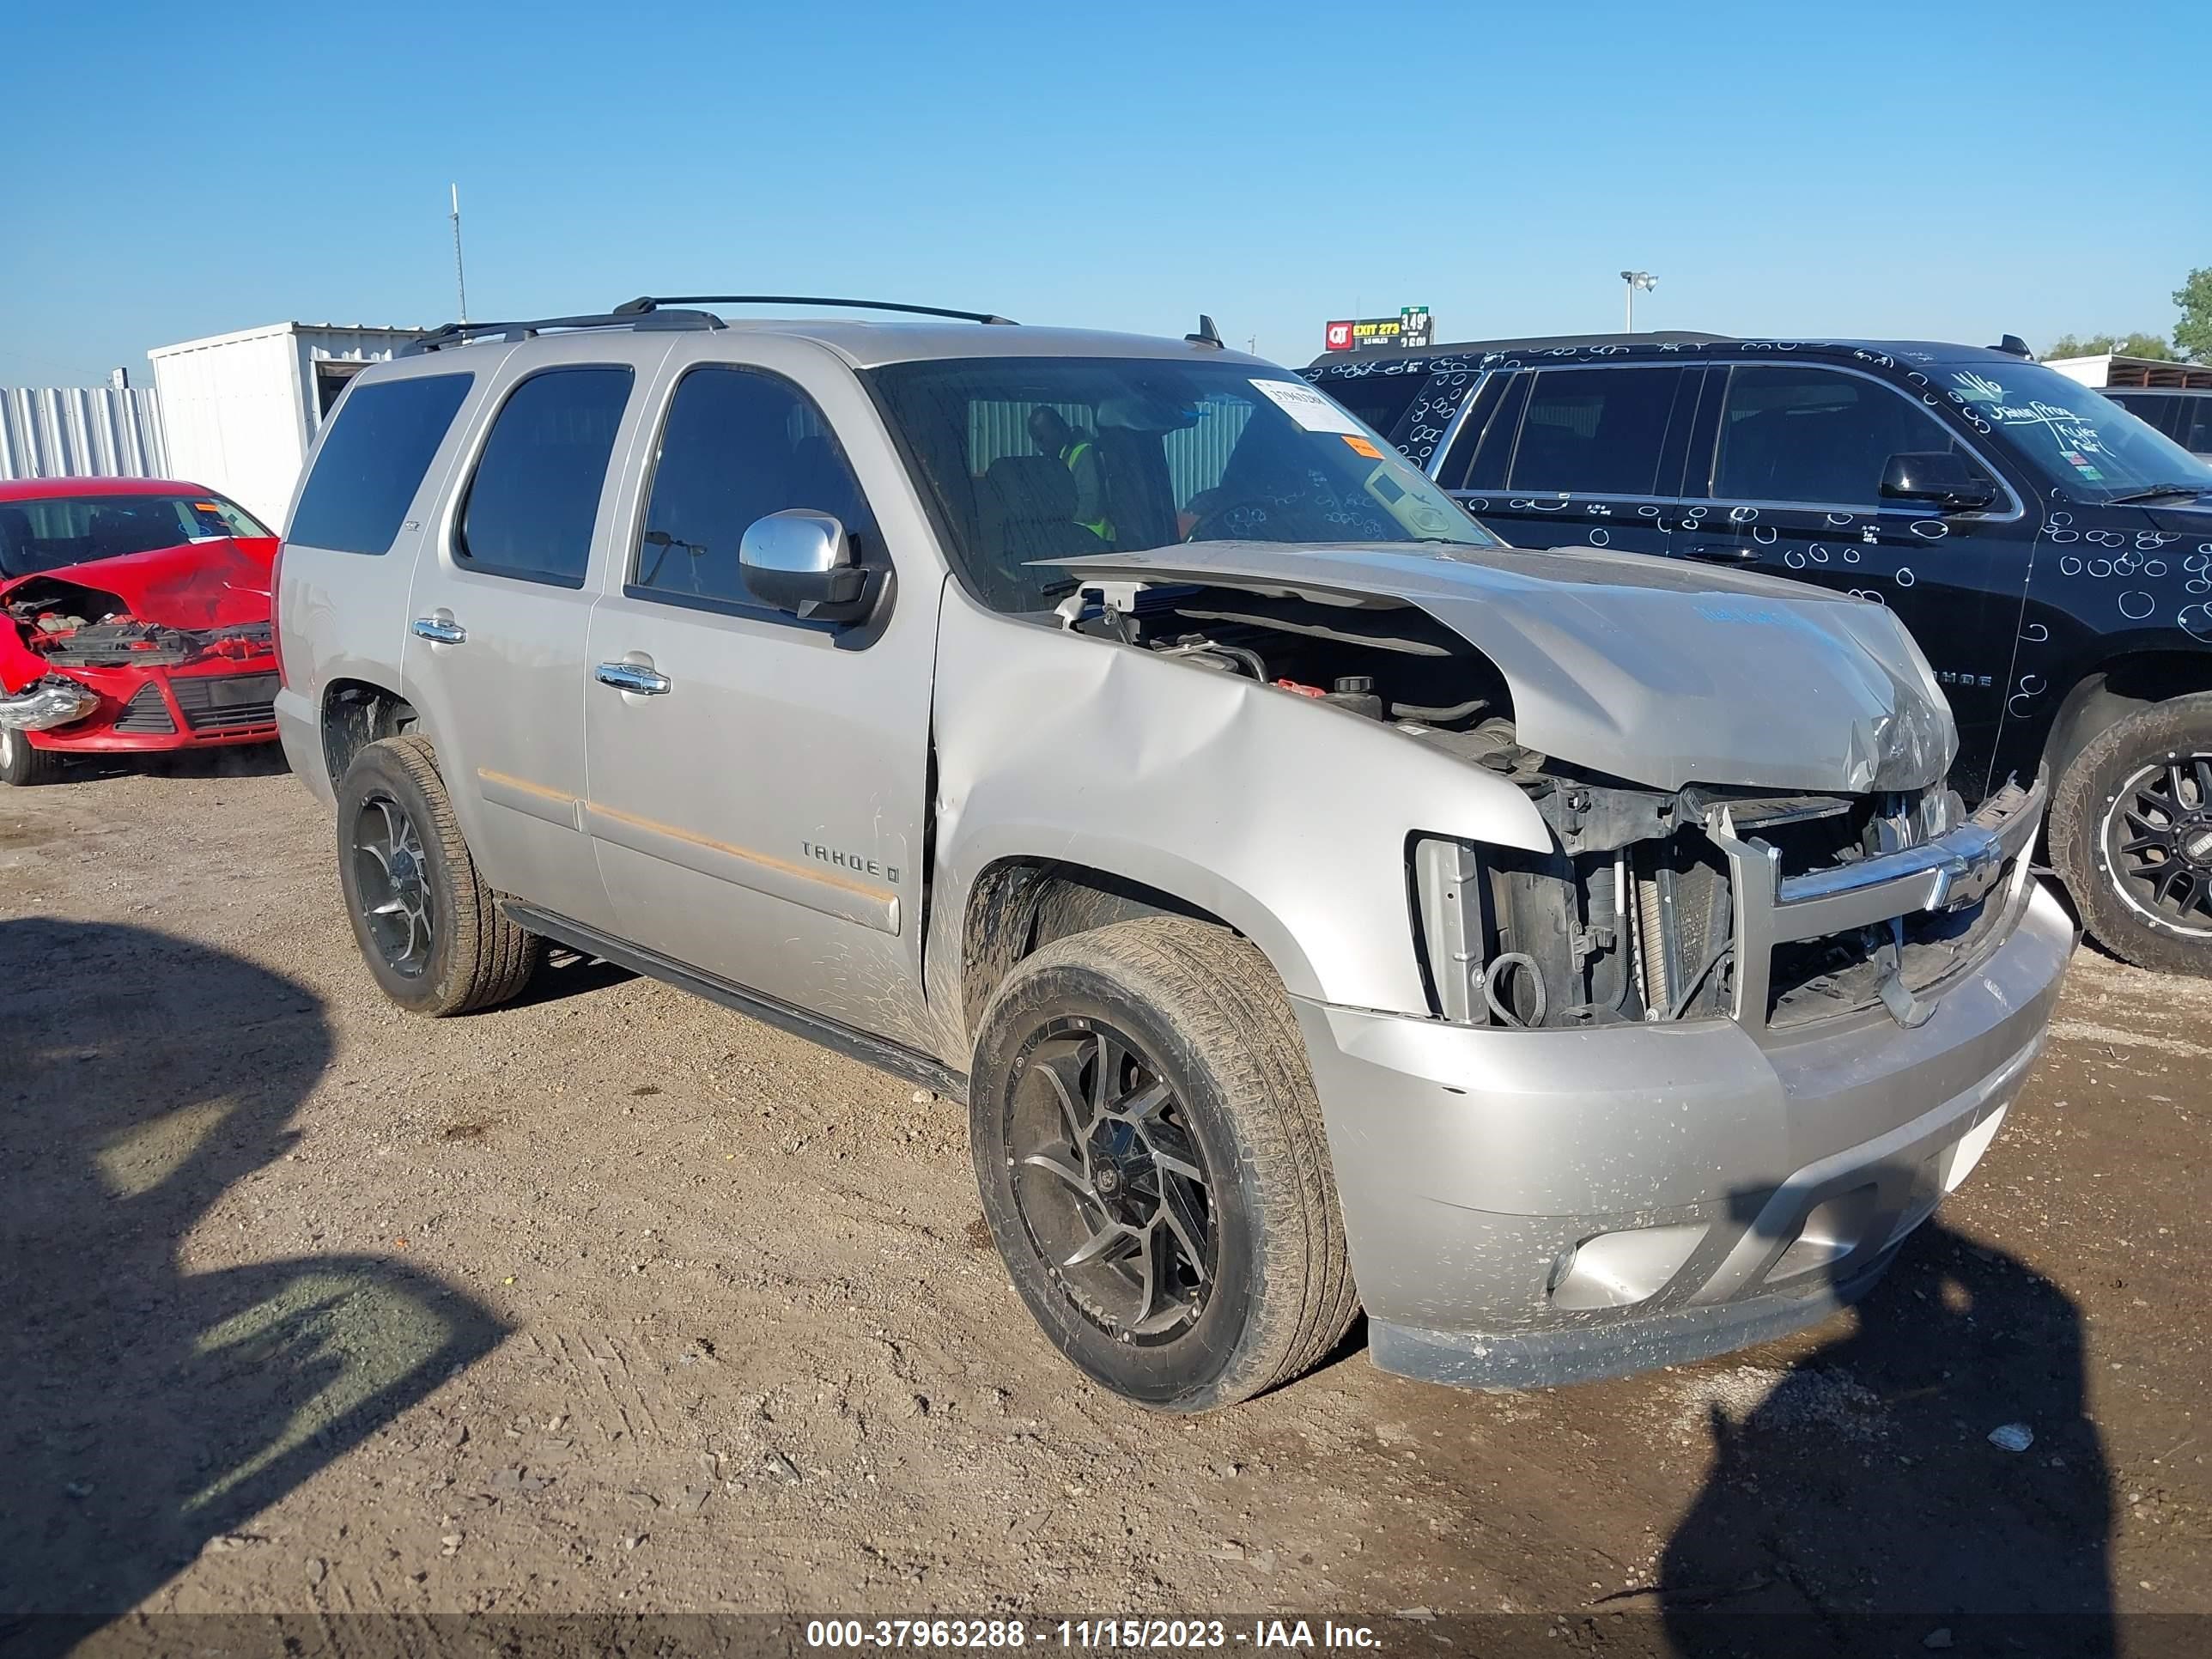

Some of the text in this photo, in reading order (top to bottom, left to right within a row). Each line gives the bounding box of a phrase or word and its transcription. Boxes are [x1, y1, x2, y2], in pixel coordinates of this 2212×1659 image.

[1329, 326, 1348, 344] QT
[1352, 323, 1400, 337] EXIT 273
[802, 840, 881, 877] TAHOE
